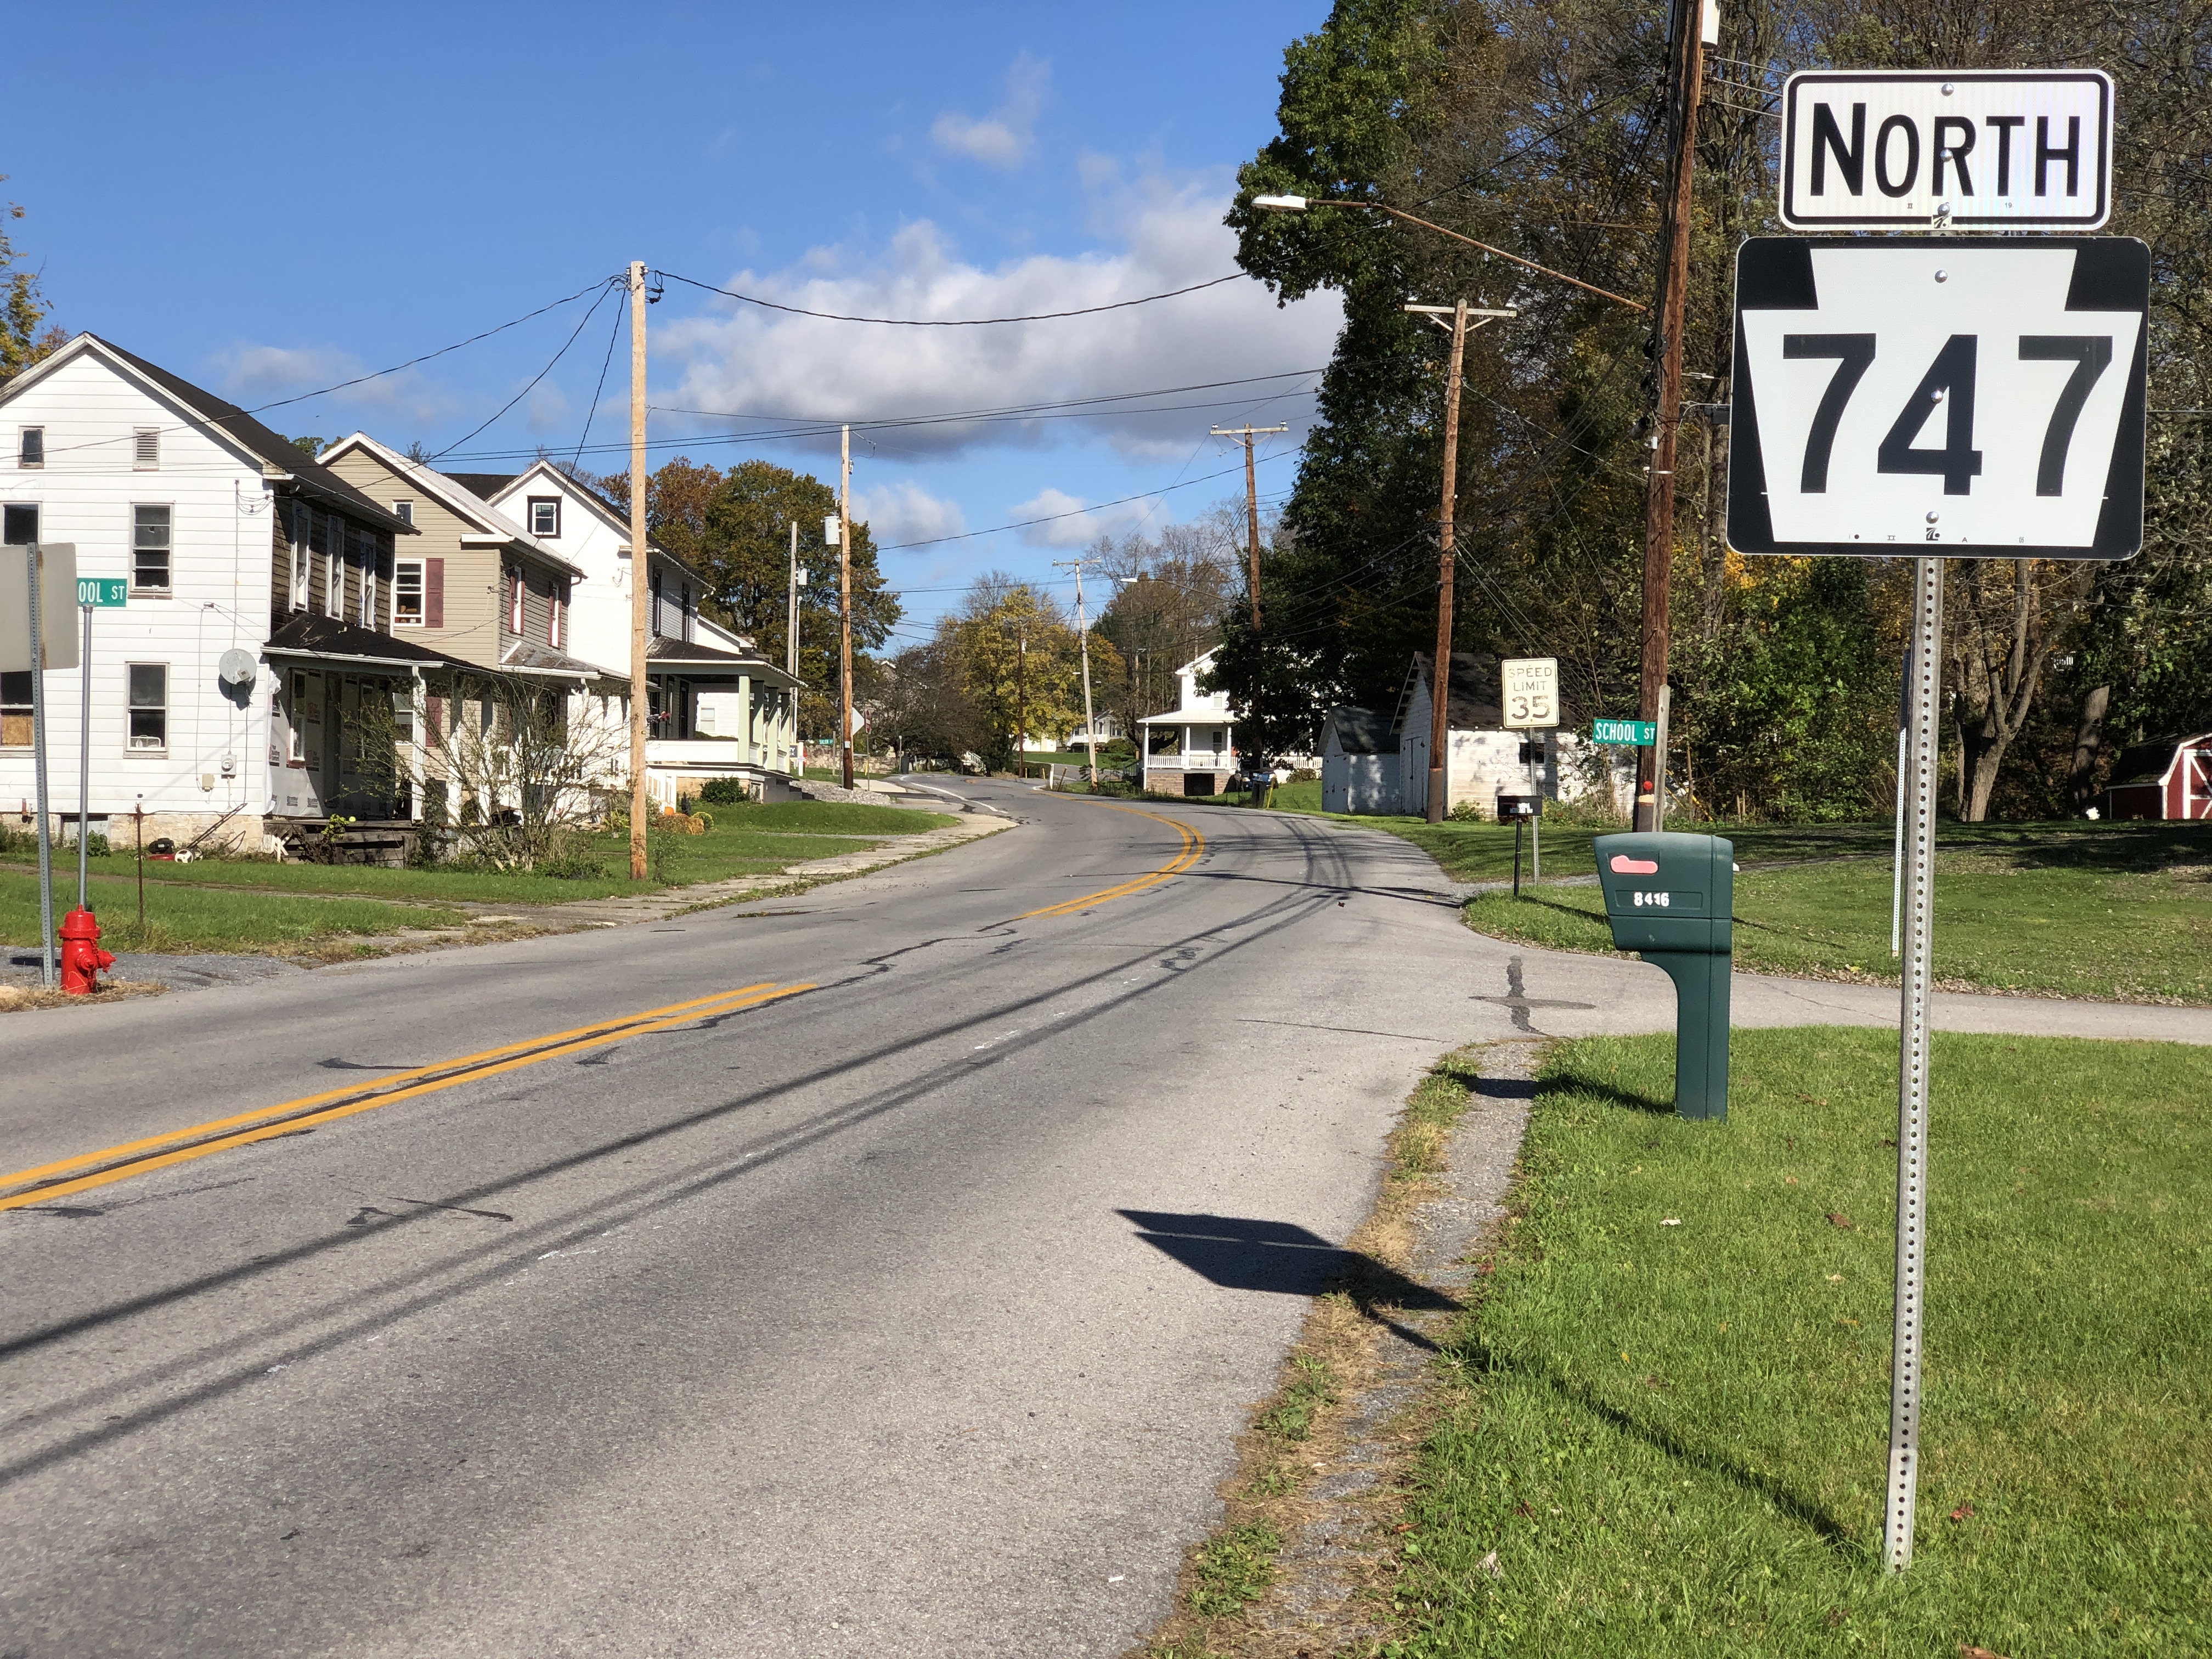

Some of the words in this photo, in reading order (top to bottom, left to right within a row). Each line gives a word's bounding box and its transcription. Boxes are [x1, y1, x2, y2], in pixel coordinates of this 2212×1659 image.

[1810, 103, 2080, 198] NORTH
[1783, 333, 2113, 496] 747
[78, 582, 103, 602] OOL
[111, 585, 125, 600] ST
[1508, 667, 1552, 678] SPEED
[1514, 681, 1547, 691] LIMIT
[1511, 695, 1550, 720] 35
[1595, 722, 1637, 742] SCHOOL
[1644, 727, 1655, 740] ST
